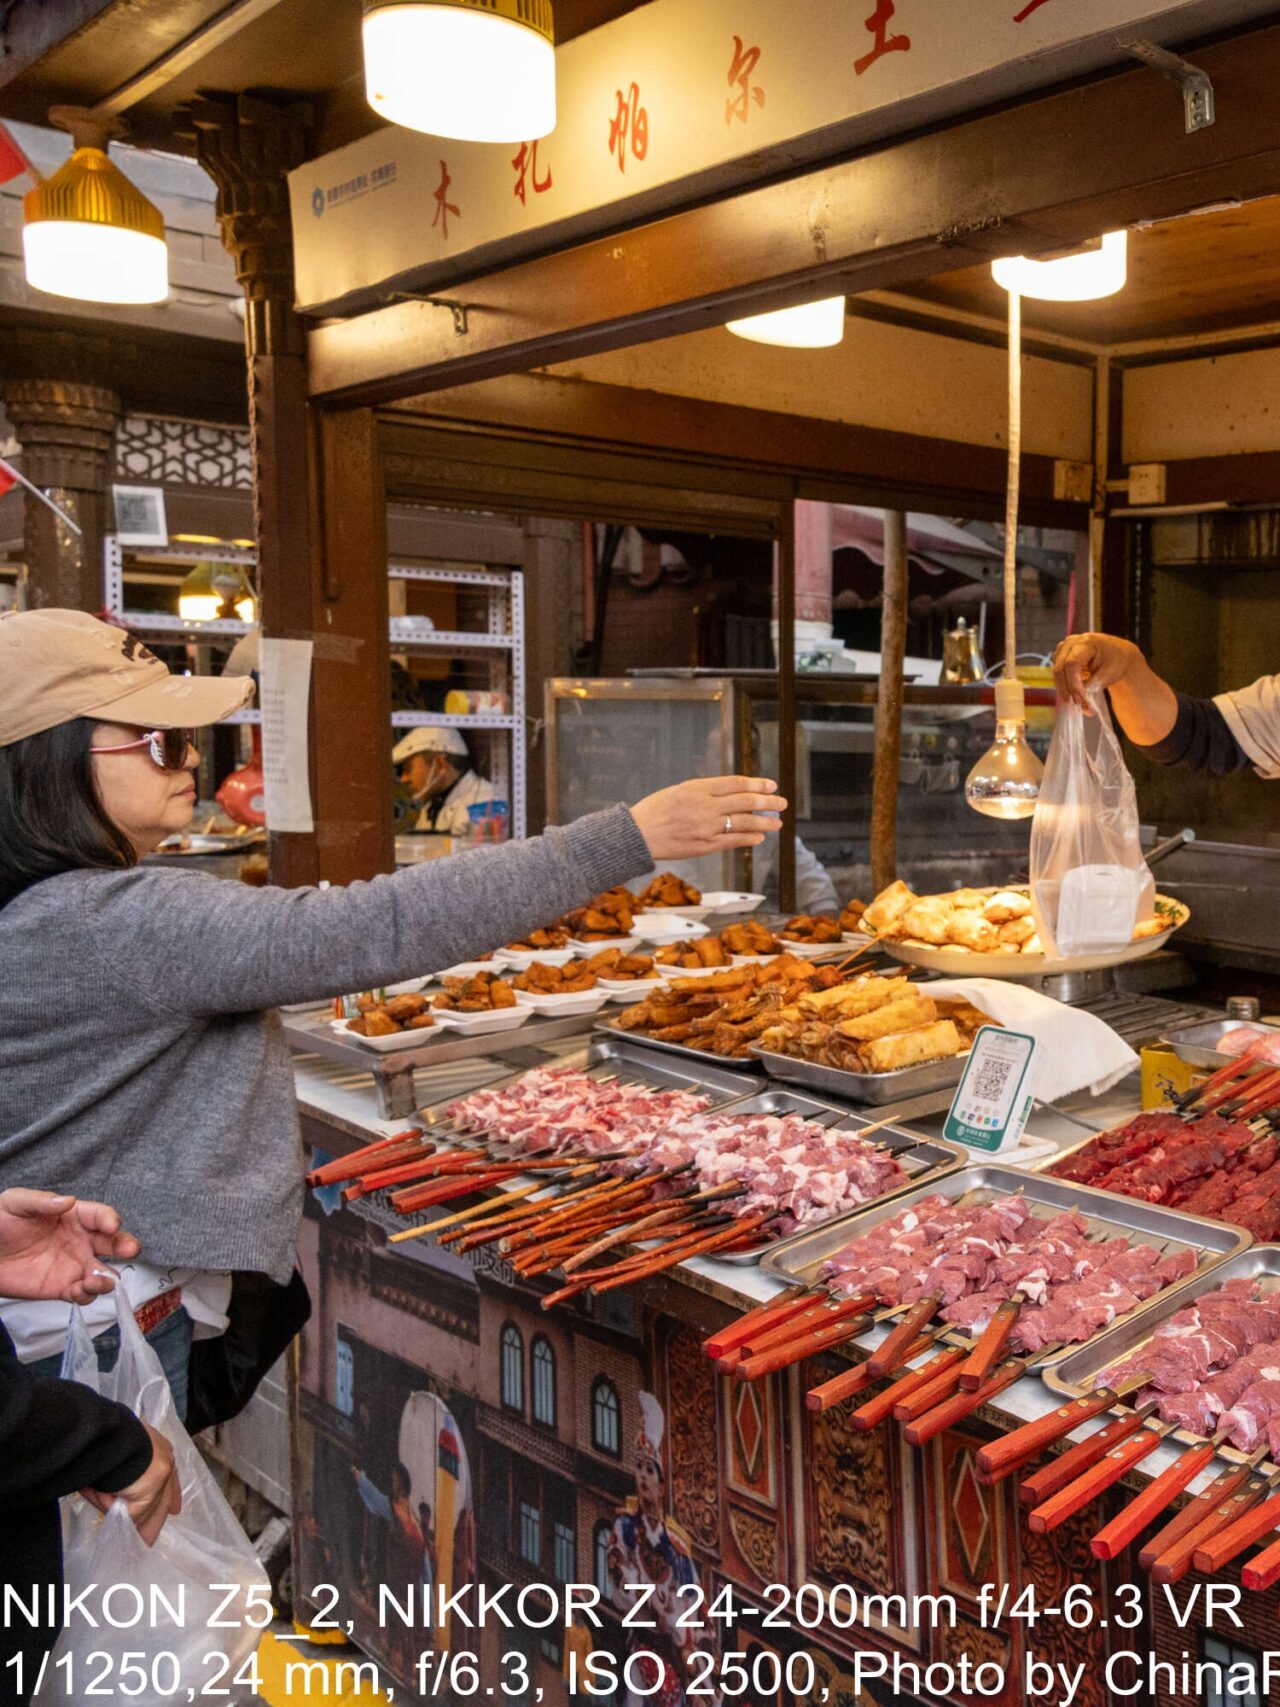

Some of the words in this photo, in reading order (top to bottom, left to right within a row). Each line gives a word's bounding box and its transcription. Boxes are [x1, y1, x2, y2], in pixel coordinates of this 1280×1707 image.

[431, 0, 1050, 241] 木扎帕尔土
